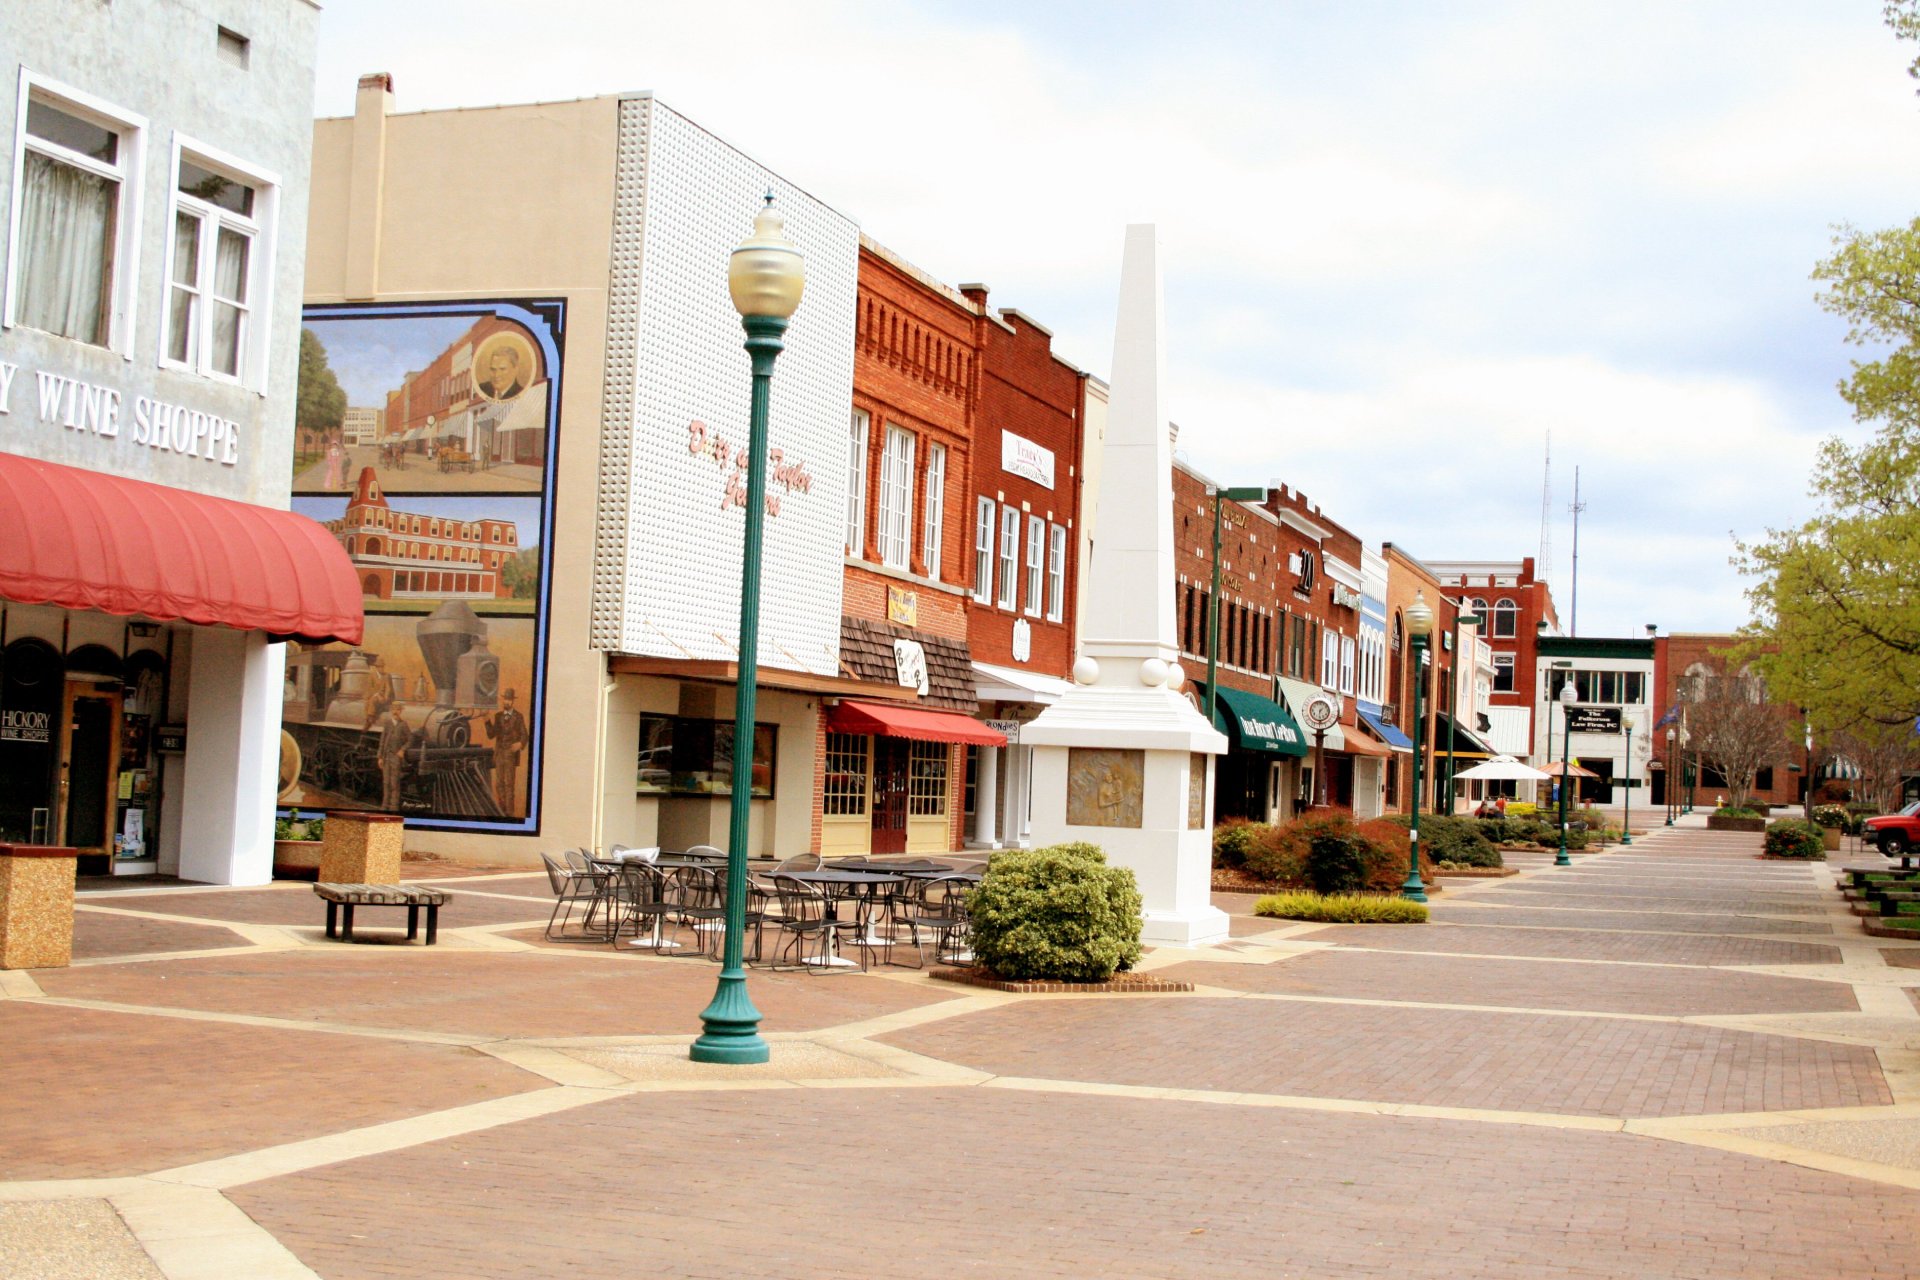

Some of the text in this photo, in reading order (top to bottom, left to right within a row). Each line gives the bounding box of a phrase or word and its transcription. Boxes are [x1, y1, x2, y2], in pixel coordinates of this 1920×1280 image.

[36, 370, 122, 438] WINE
[132, 395, 242, 466] SHOPPE
[2, 709, 51, 729] HICKORY
[1, 729, 50, 741] WINE SHOPPE
